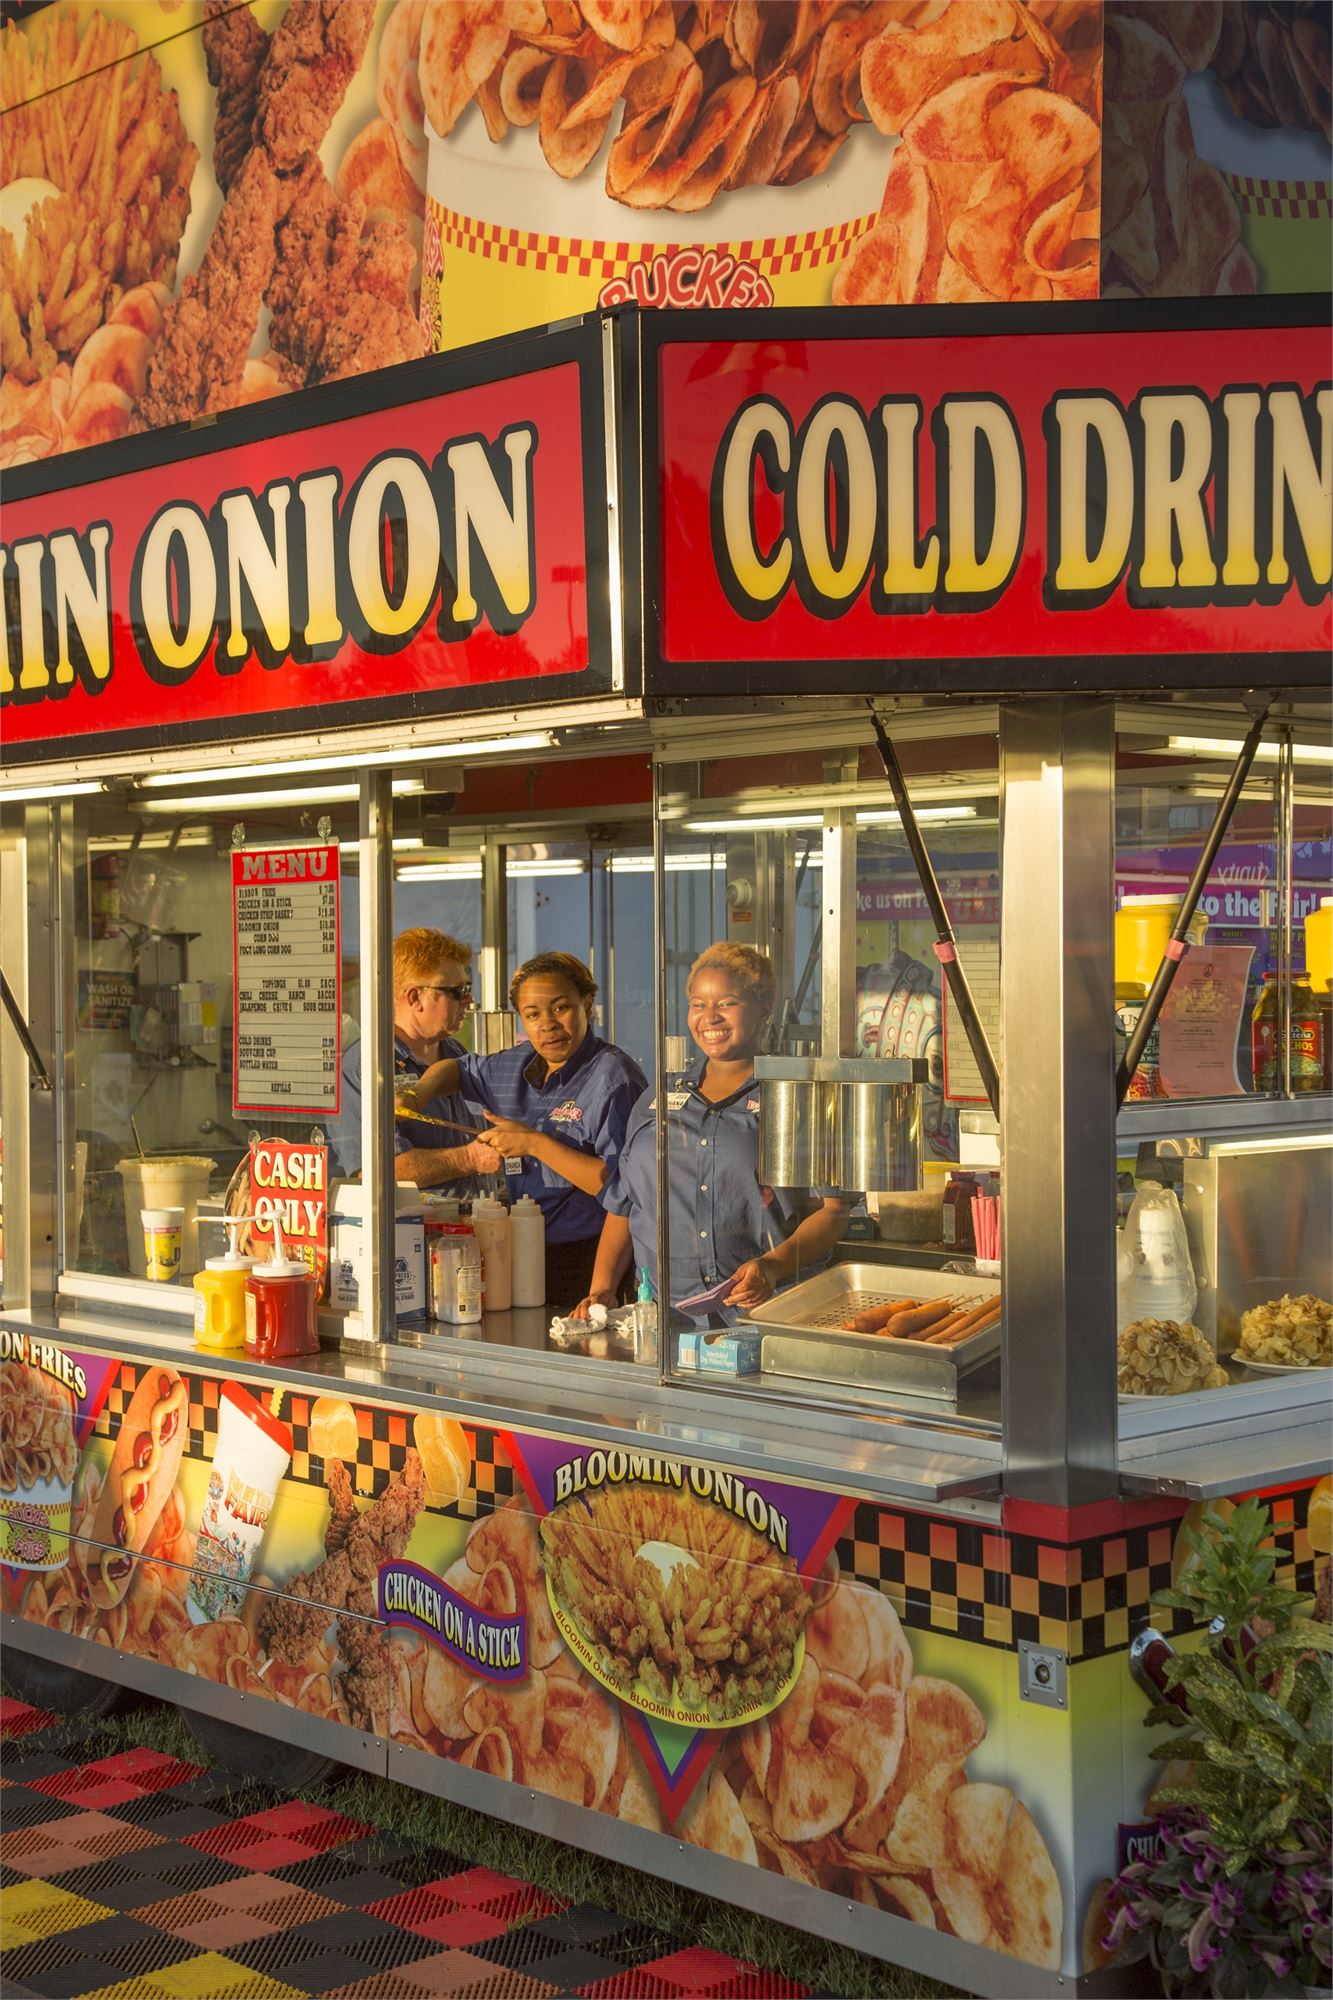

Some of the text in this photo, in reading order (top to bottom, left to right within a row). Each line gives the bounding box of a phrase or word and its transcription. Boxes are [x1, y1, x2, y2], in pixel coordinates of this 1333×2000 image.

[722, 401, 1022, 600] COLD
[0, 429, 533, 692] IN ONION
[242, 851, 329, 880] MENU
[238, 900, 260, 909] CHICKEN
[263, 899, 270, 908] ON
[271, 899, 275, 908] A
[276, 898, 292, 907] STICK
[1196, 892, 1220, 917] to
[1226, 890, 1260, 918] the
[238, 911, 259, 920] CHICKEN
[260, 910, 274, 919] STRIP
[238, 923, 261, 932] BLOOMIN
[263, 922, 279, 931] ONION
[254, 934, 267, 943] CORN
[253, 946, 266, 955] LONG
[267, 945, 280, 954] CORN
[281, 945, 292, 954] DOG
[262, 980, 286, 988] TOPPINGS
[320, 979, 335, 988] EACH
[87, 983, 134, 996] WASH OR
[259, 992, 278, 1000] CHEESE
[317, 991, 335, 999] BACON
[88, 996, 133, 1007] SANITIZE
[239, 1003, 266, 1012] JALAPENOS
[303, 1003, 316, 1011] SOUR
[318, 1003, 335, 1011] CREAM
[239, 1037, 252, 1046] COLD
[253, 1037, 272, 1046] DRINKS
[266, 1048, 276, 1058] CUP
[239, 1060, 260, 1069] BOTTLED
[262, 1061, 278, 1070] WATER
[271, 1083, 291, 1093] REFILLS
[254, 1151, 324, 1190] CASH
[29, 1344, 87, 1399] FRIES
[555, 1450, 788, 1553] BLOOMIN ONION
[224, 1493, 269, 1530] FAIR
[14, 1538, 46, 1561] FRIES
[384, 1572, 521, 1668] CHICKEN ON A STICK
[556, 1610, 593, 1663] BLOOMIN
[593, 1661, 622, 1692] ONION
[630, 1692, 675, 1719] BLOOMIN
[677, 1711, 710, 1723] ONION
